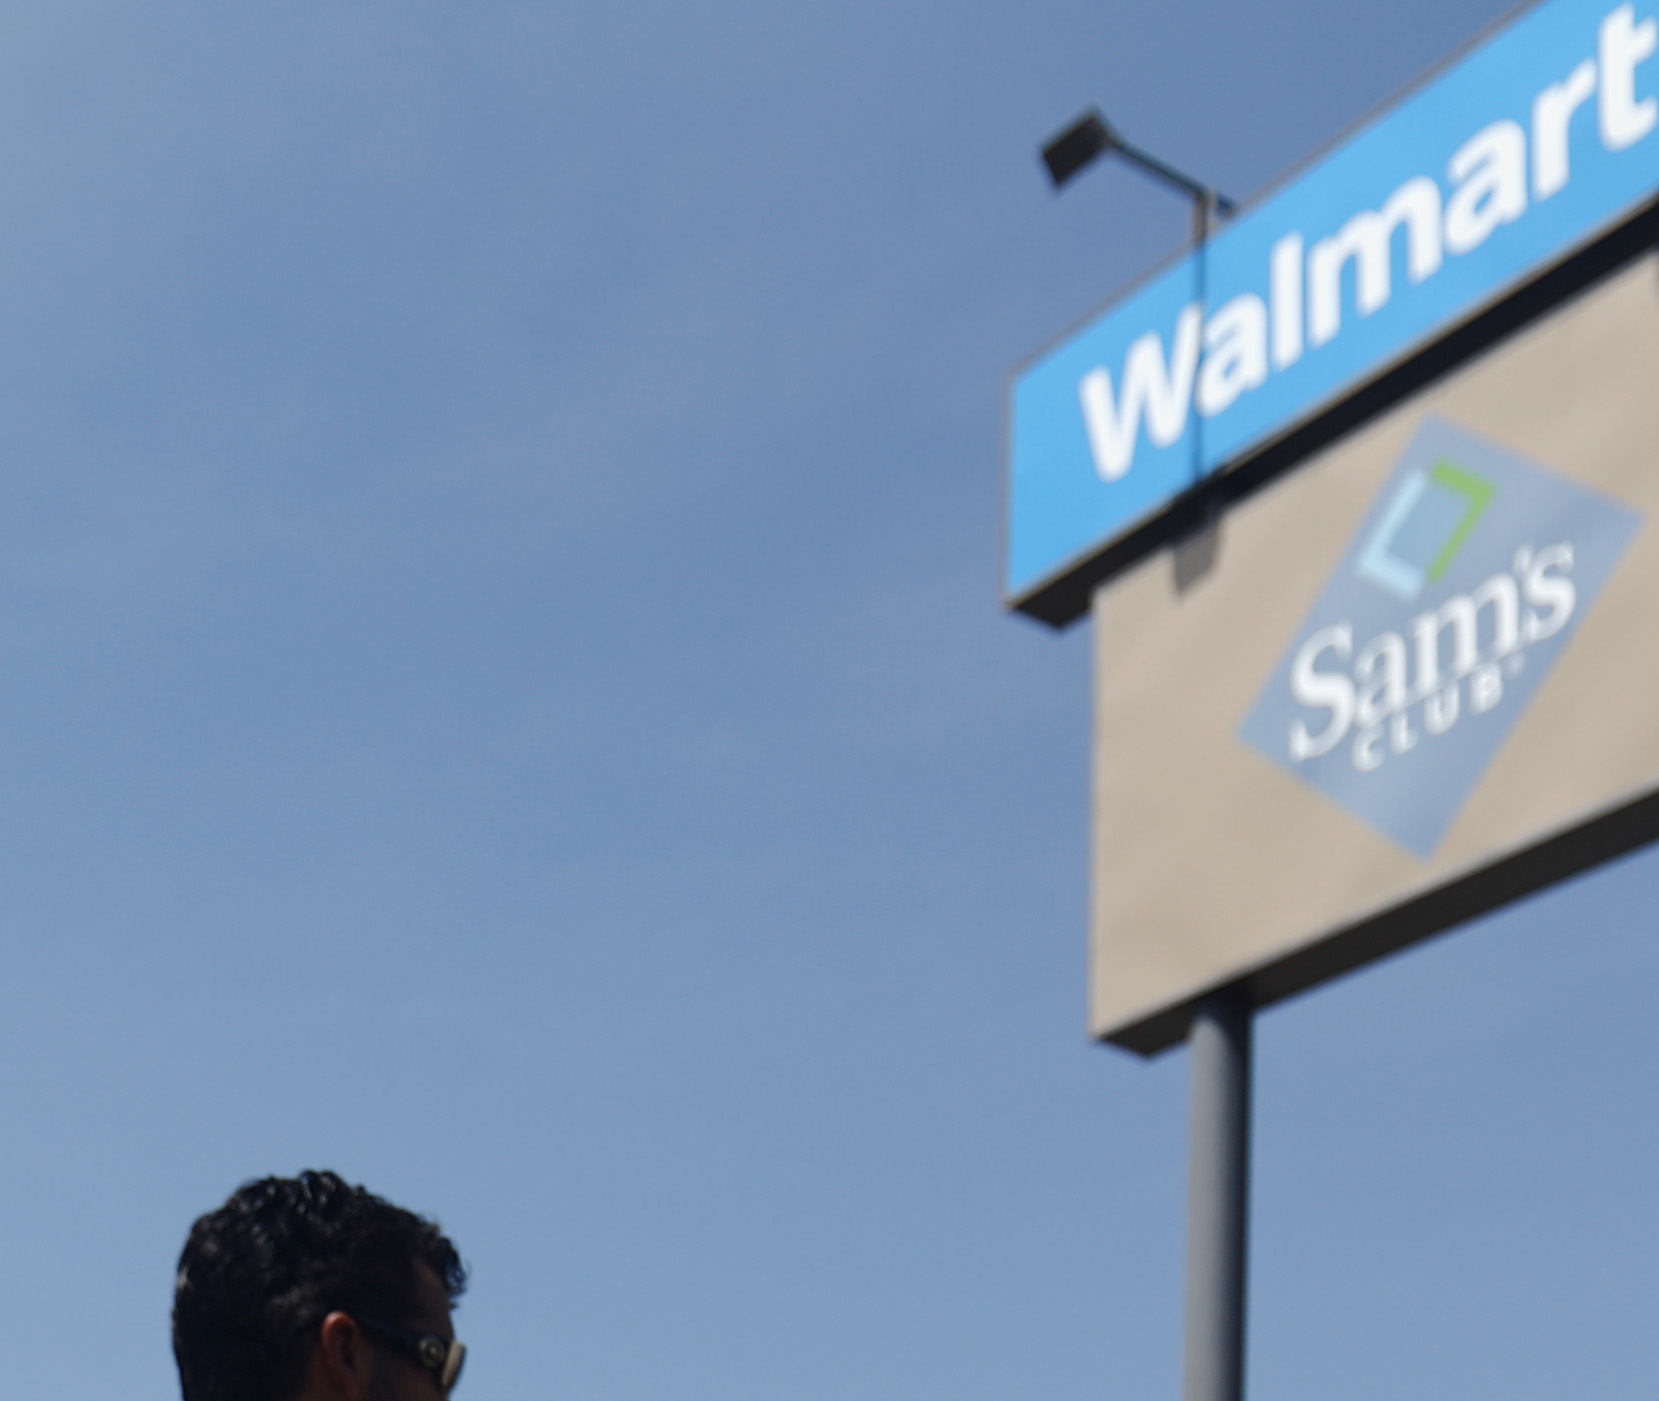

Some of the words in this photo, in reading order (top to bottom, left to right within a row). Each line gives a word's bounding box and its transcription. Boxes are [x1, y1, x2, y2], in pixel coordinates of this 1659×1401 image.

[1079, 2, 1659, 484] Walmart
[1288, 541, 1576, 763] Sam's
[1352, 661, 1504, 772] CLUB
